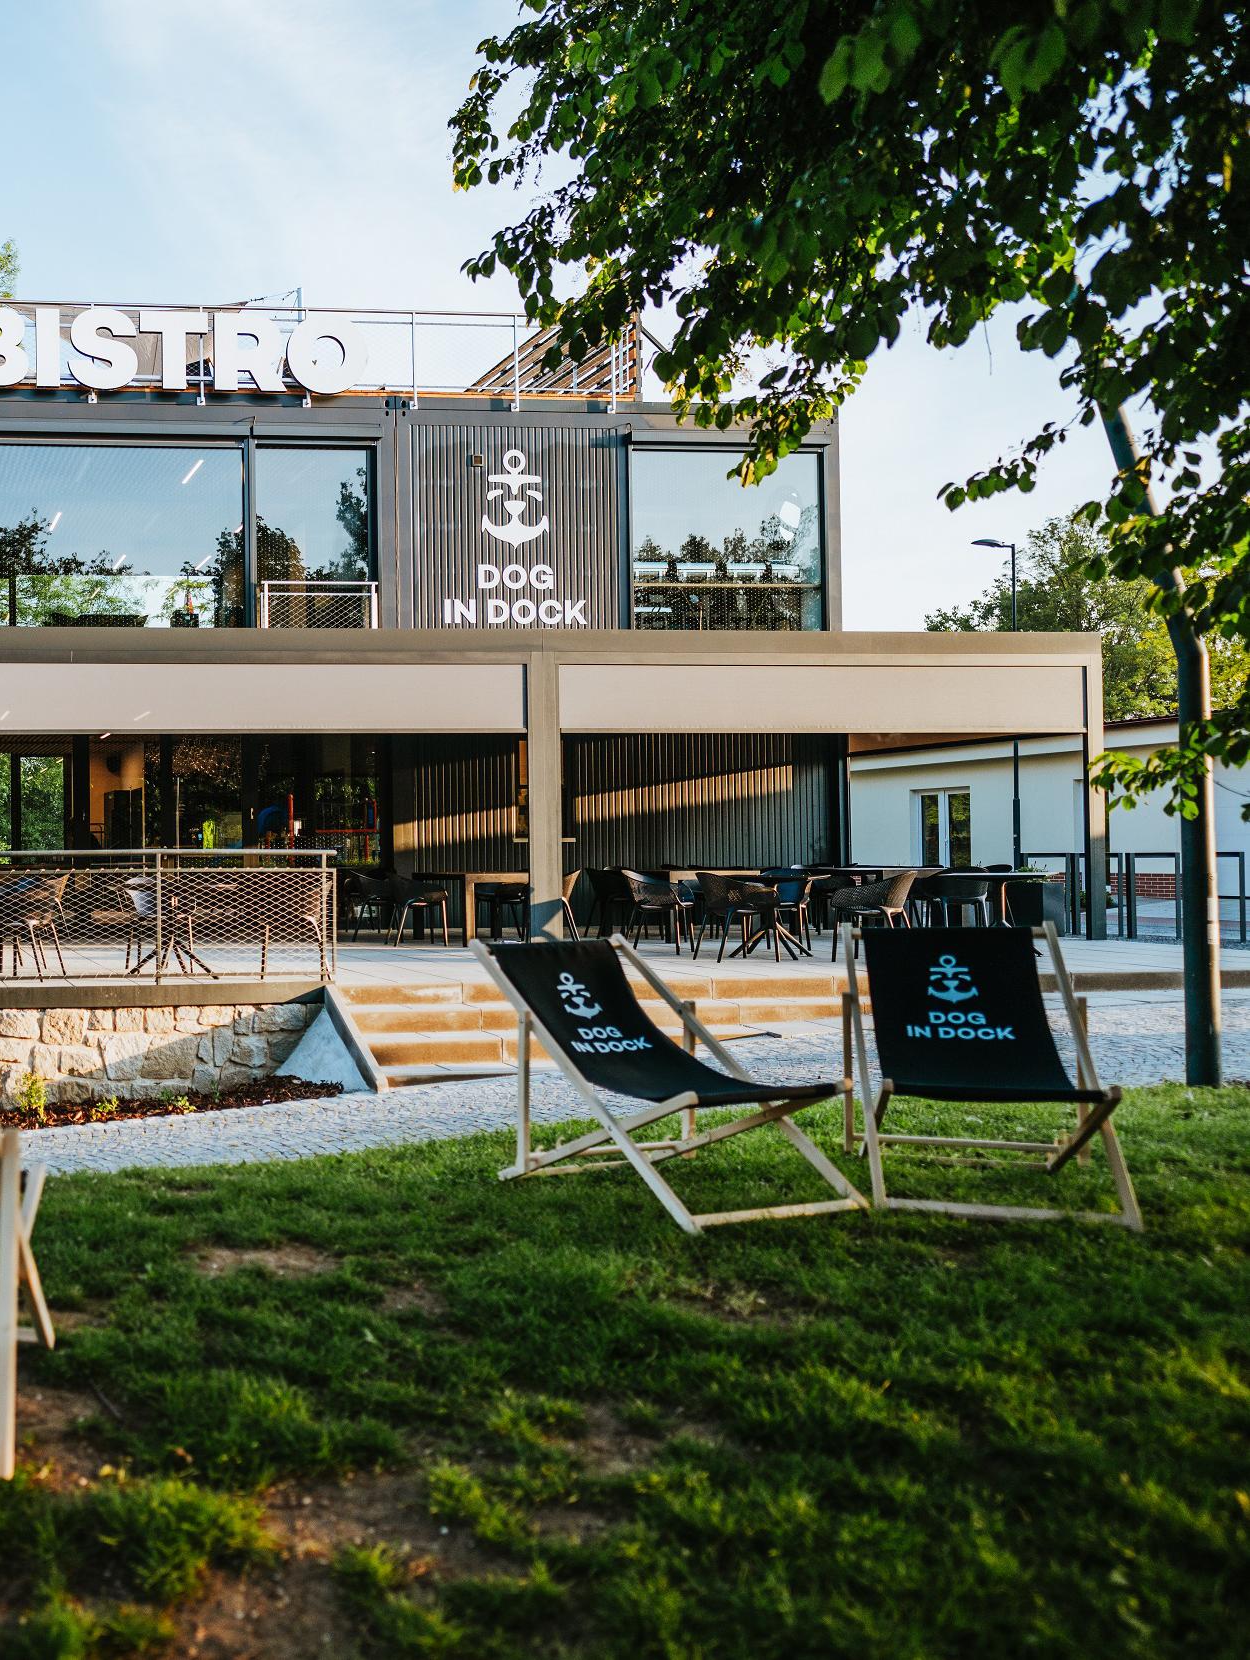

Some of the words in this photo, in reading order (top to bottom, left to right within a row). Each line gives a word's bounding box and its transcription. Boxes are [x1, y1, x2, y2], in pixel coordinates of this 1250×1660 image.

[478, 563, 554, 590] DOG
[444, 598, 477, 625] IN
[487, 598, 588, 625] DOCK
[928, 1011, 987, 1025] DOG
[577, 1026, 623, 1040] DOG
[906, 1025, 932, 1038] IN
[938, 1027, 1016, 1040] DOCK
[571, 1040, 595, 1053] IN
[594, 1037, 653, 1054] DOCK
